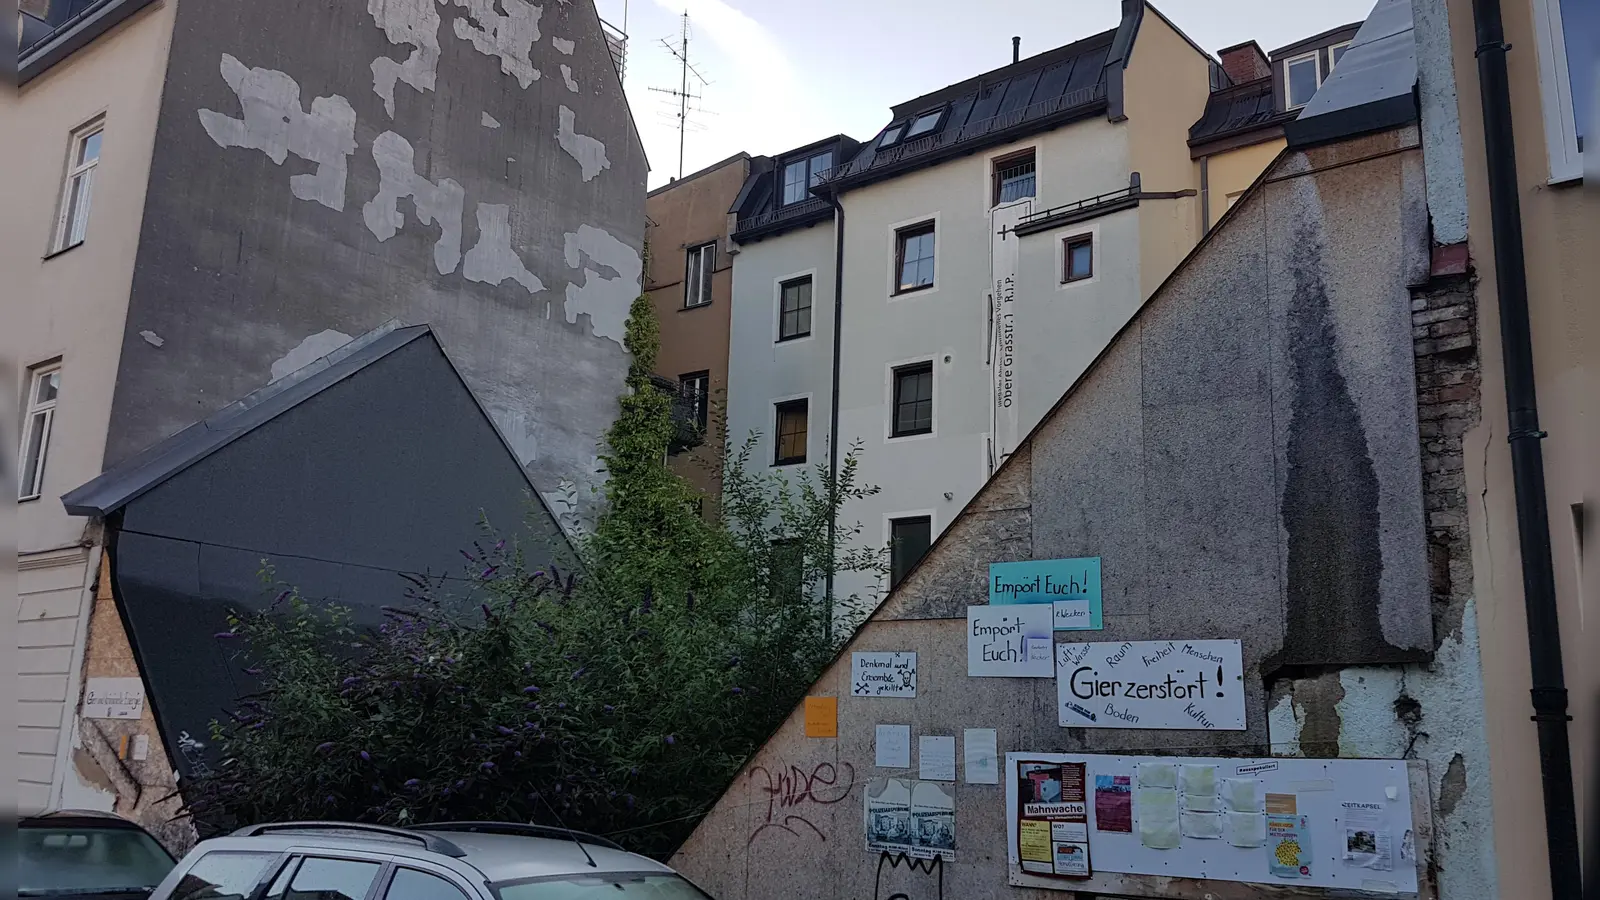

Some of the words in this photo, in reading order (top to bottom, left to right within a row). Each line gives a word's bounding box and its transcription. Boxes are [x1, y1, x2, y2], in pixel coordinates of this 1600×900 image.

[995, 279, 1003, 311] Vorgehen
[1004, 273, 1014, 303] R.I.P.
[1003, 370, 1012, 408] Obere
[995, 575, 1040, 598] Empört
[1046, 570, 1087, 594] Euch!
[973, 617, 1025, 641] Empört
[983, 635, 1024, 662] Euch!
[1058, 647, 1073, 668] Luft
[1073, 643, 1091, 666] Wasser
[1106, 642, 1133, 668] Raum
[1142, 642, 1176, 668] Freiheit
[1181, 644, 1223, 663] Menschen
[860, 658, 892, 668] Denkmal
[894, 658, 909, 669] und
[1104, 703, 1140, 723] Boden
[1184, 703, 1215, 729] Kultur
[1027, 804, 1083, 814] Mahnwache
